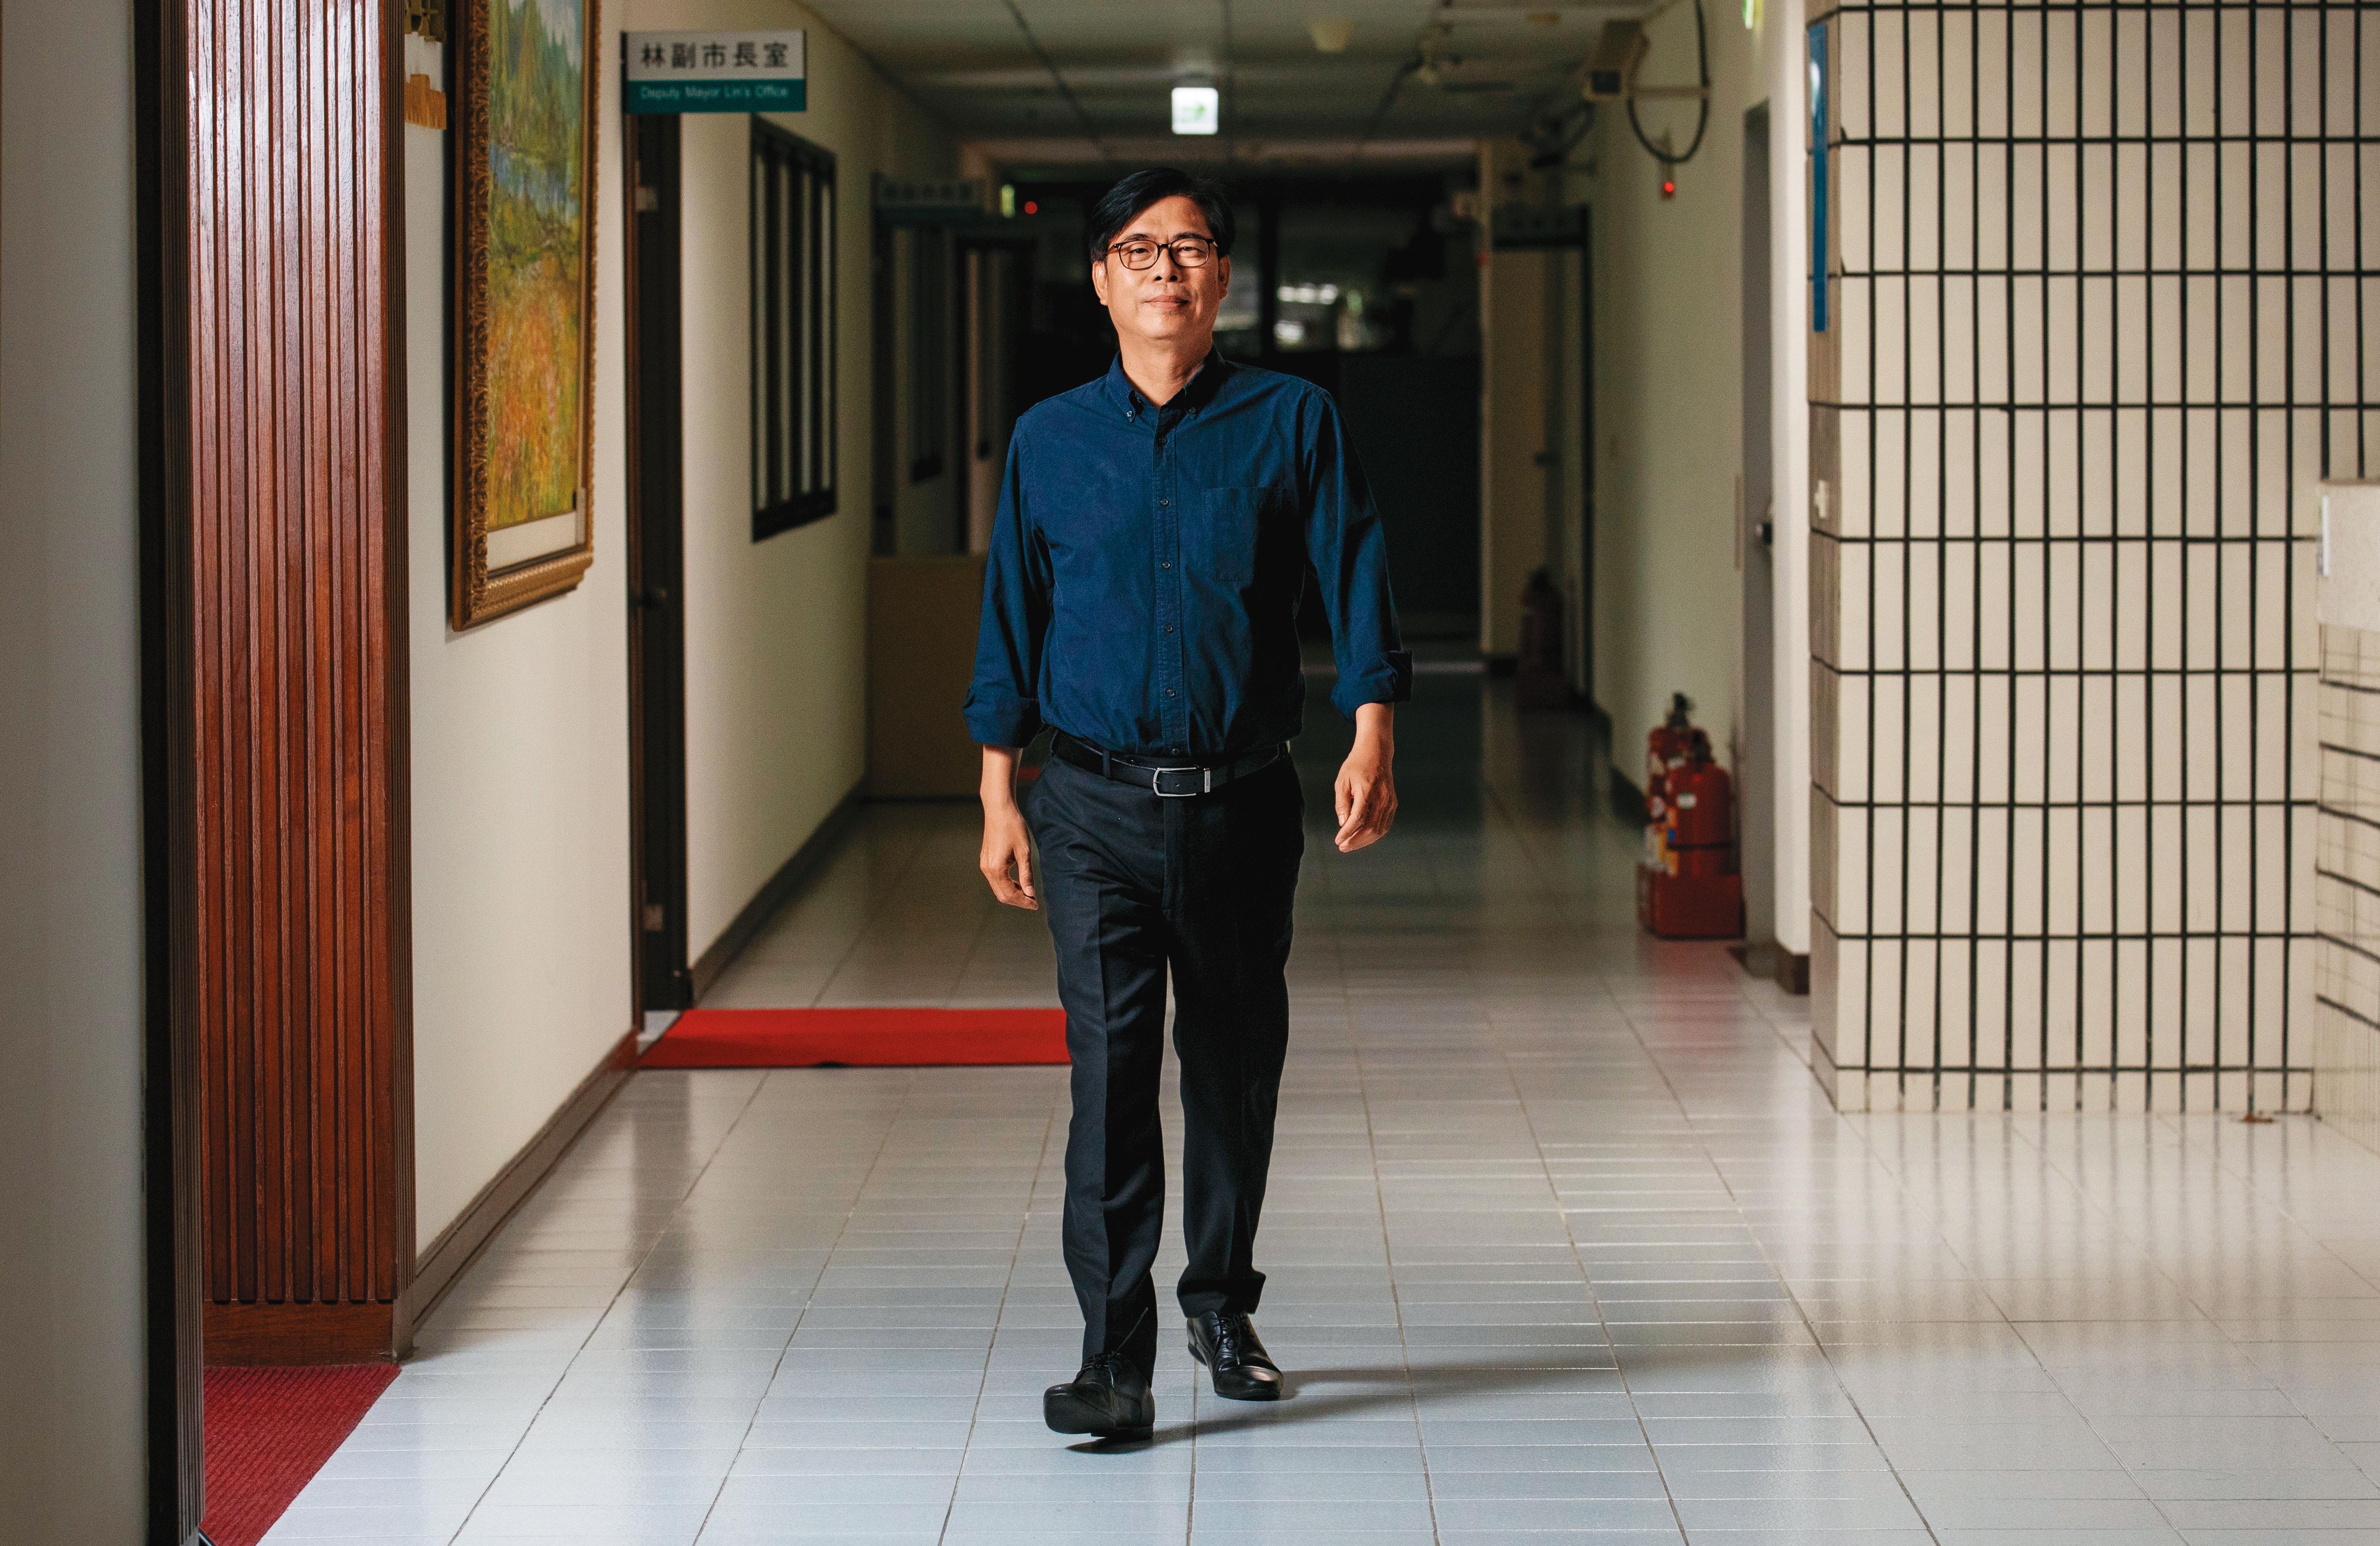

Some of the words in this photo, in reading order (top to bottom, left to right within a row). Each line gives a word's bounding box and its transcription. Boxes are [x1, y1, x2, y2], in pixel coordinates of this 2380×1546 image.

[642, 41, 788, 69] 林副市長室
[641, 86, 680, 100] Deputy
[684, 85, 720, 100] Mayor
[755, 84, 788, 97] Office
